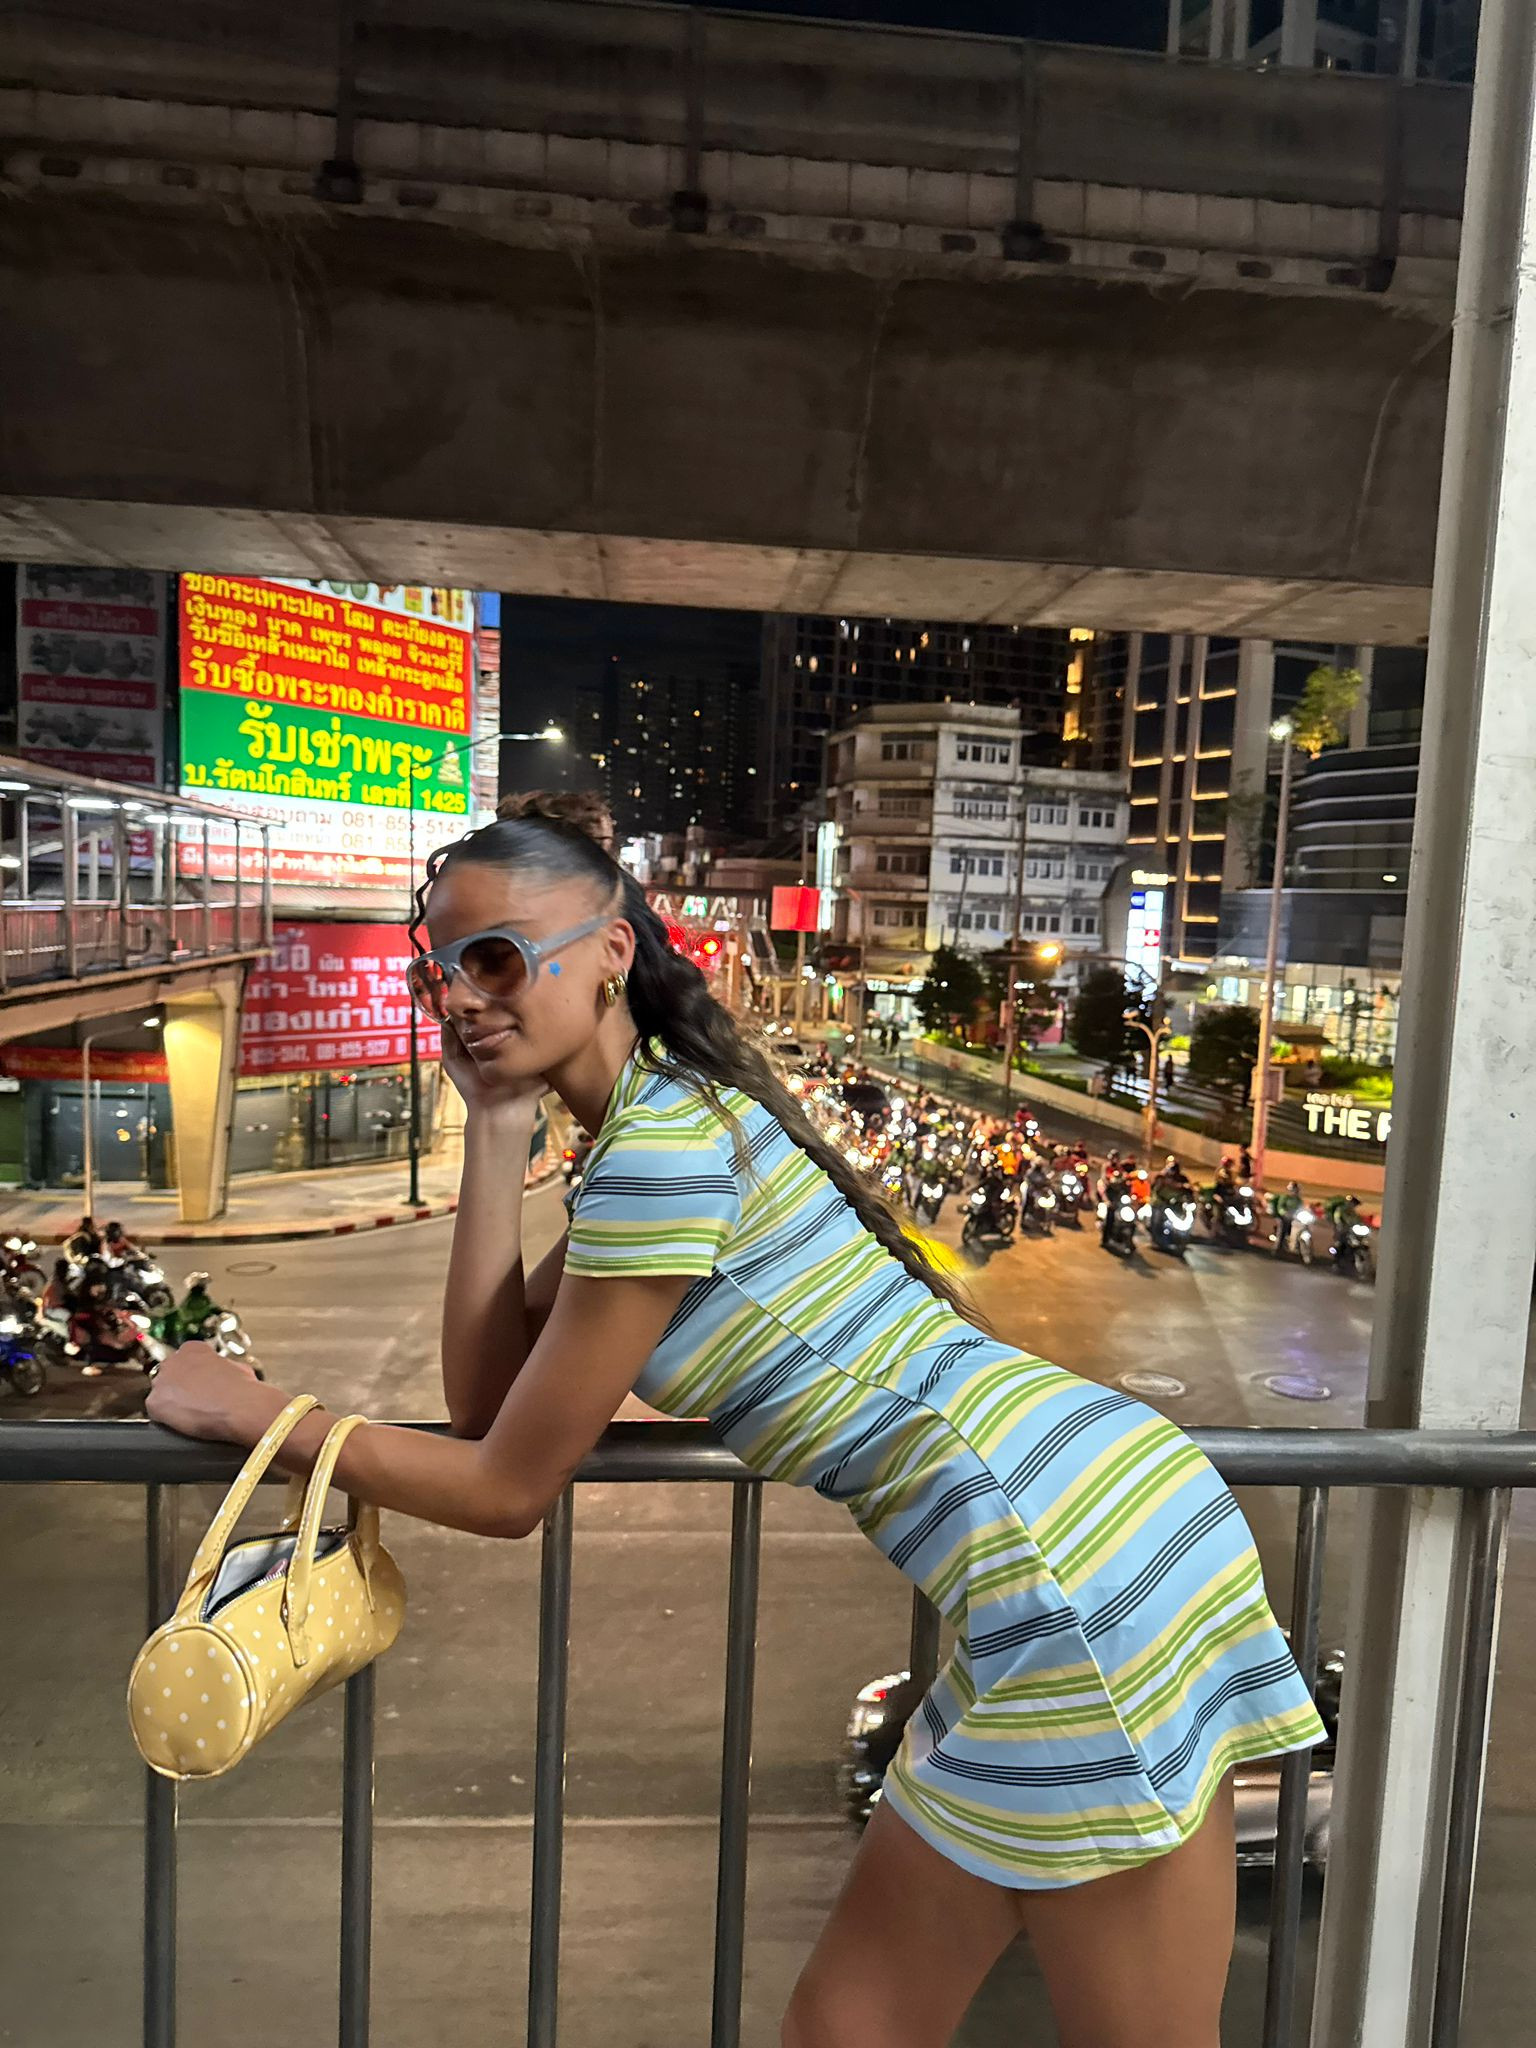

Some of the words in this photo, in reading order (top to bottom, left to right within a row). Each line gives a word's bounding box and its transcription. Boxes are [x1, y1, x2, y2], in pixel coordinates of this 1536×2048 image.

[188, 645, 466, 730] รับซื้อพระทองคำราคาดี
[238, 701, 434, 781] รับเช่าพระ
[183, 757, 353, 802] บ.รัตนโกสินทร์
[361, 776, 412, 808] เลขที่
[420, 787, 467, 815] 1425
[1302, 1103, 1372, 1140] THE
